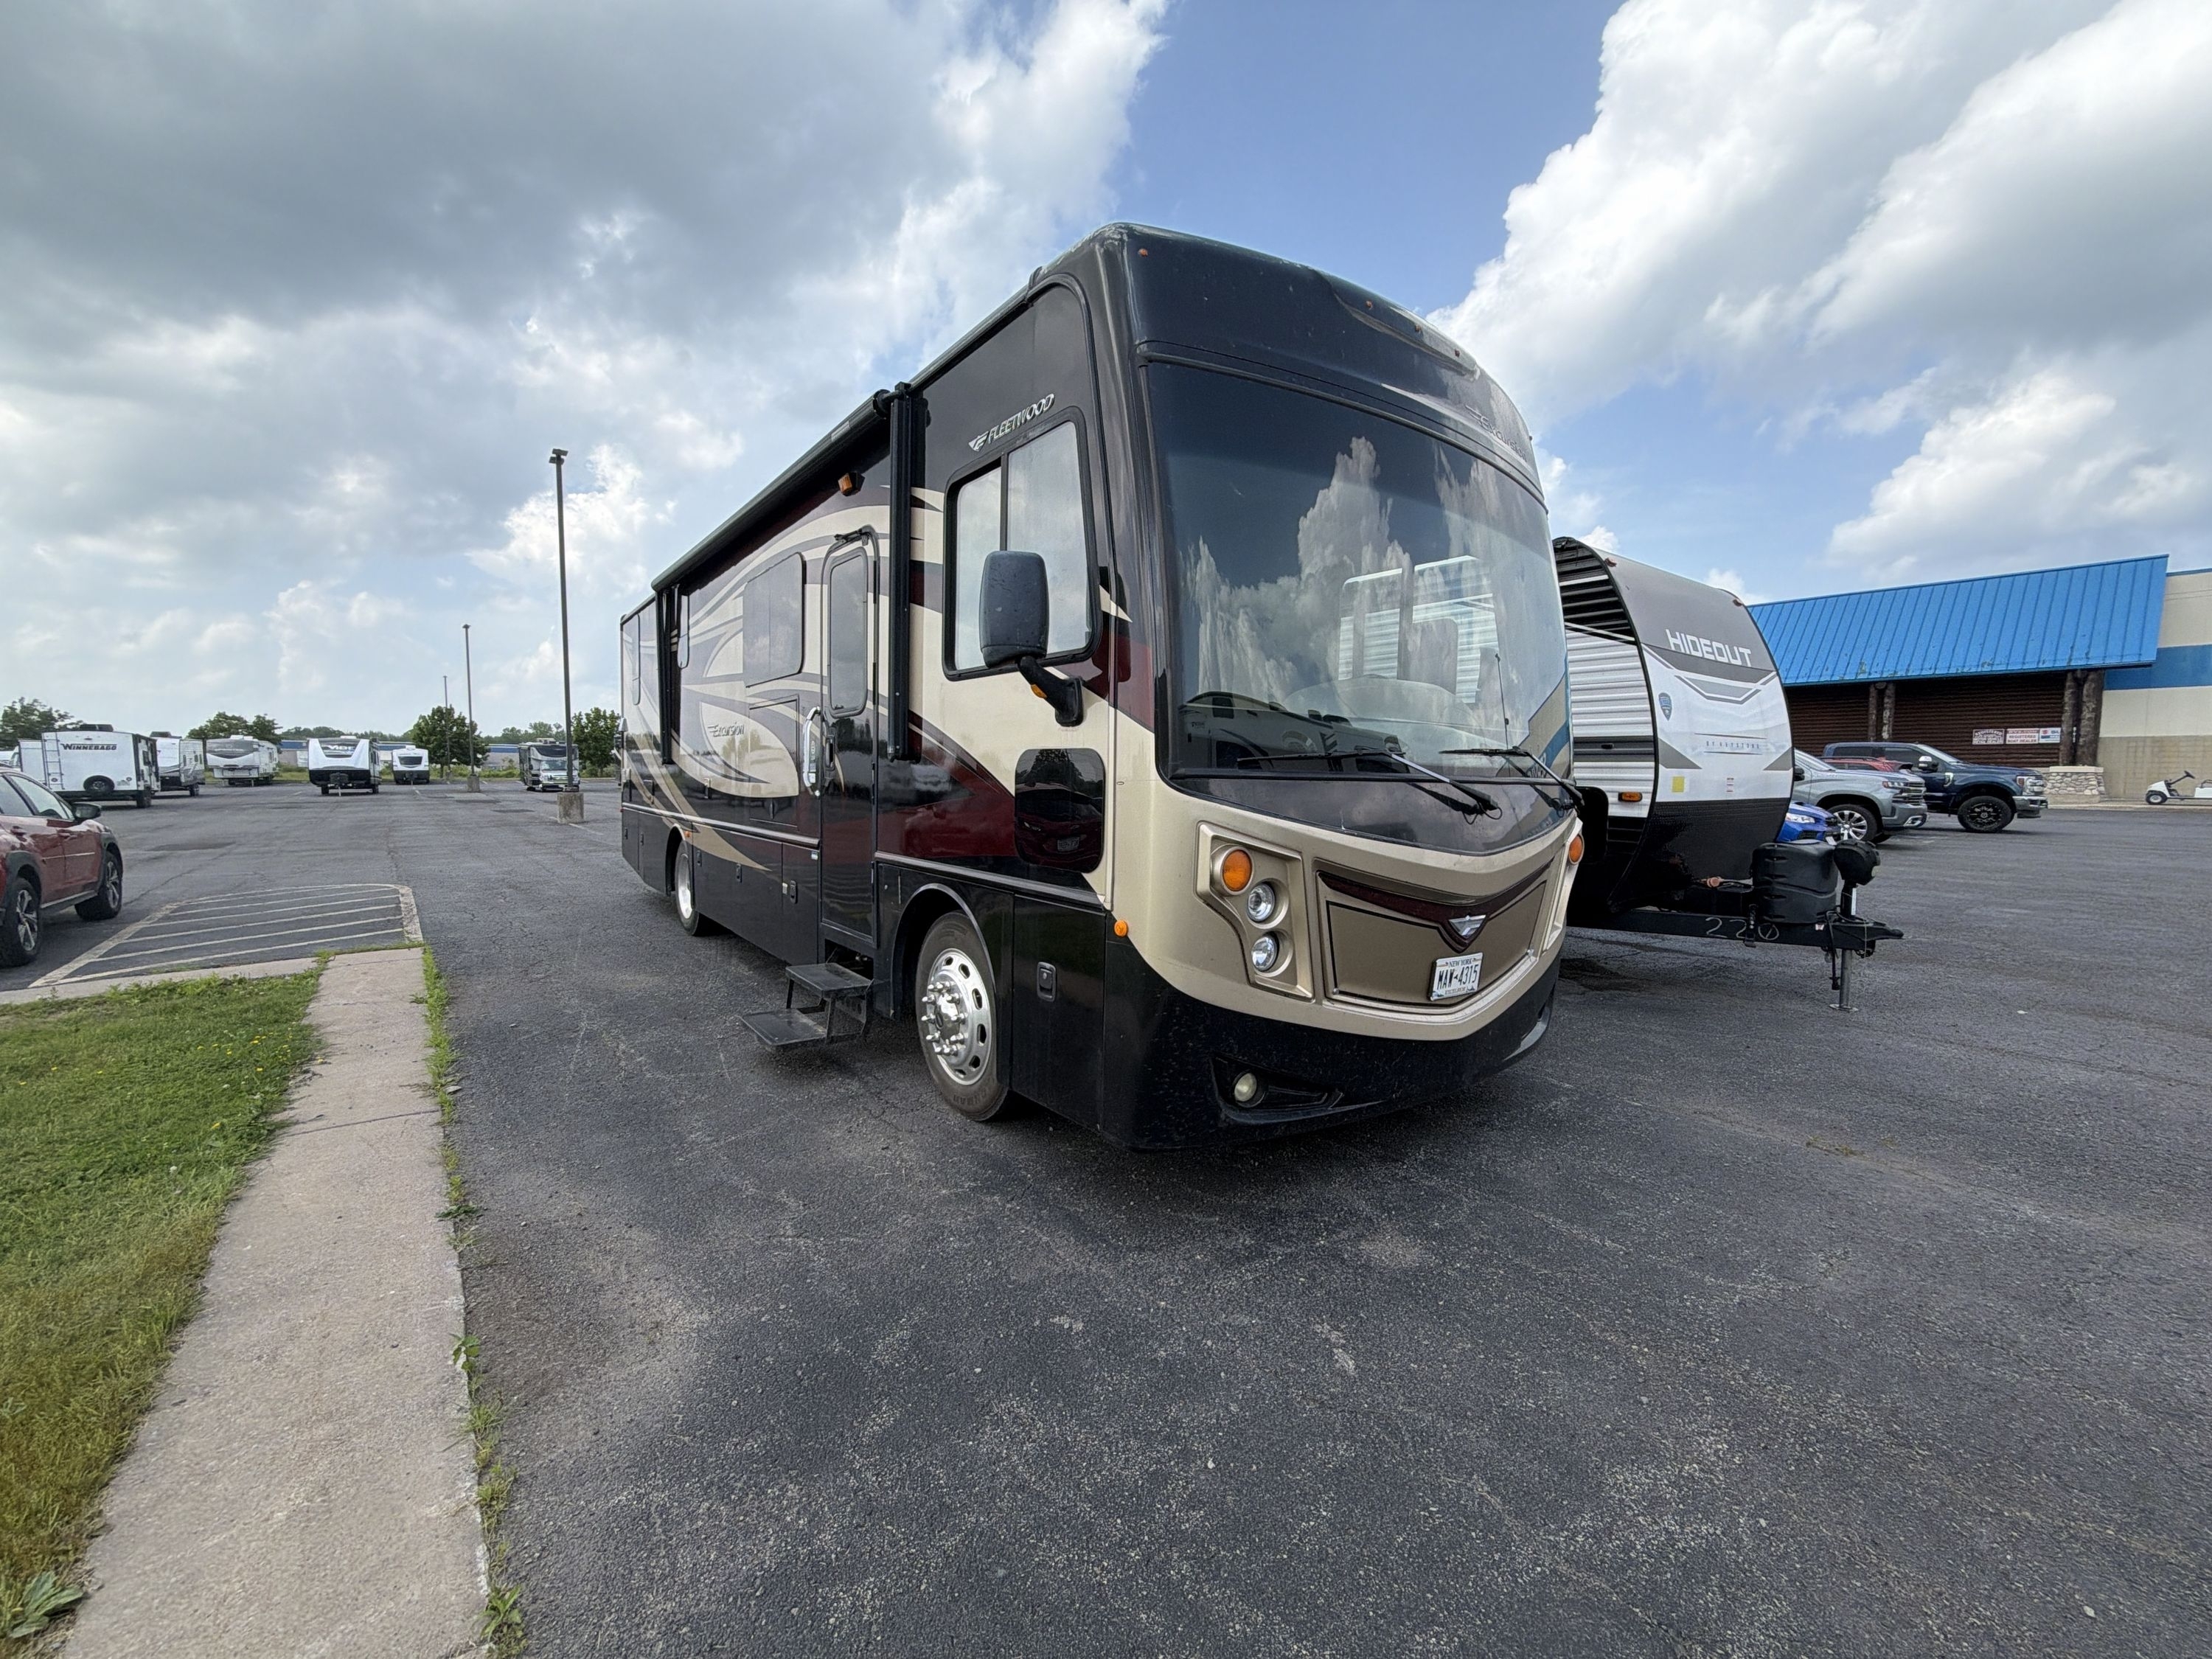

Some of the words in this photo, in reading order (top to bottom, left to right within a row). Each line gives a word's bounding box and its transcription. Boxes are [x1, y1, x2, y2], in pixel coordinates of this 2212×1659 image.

[988, 393, 1055, 444] FLEETWOOD
[1665, 628, 1752, 667] HIDEOUT
[707, 721, 745, 738] Excursion
[1449, 960, 1460, 968] NEW
[1461, 959, 1473, 967] YORK
